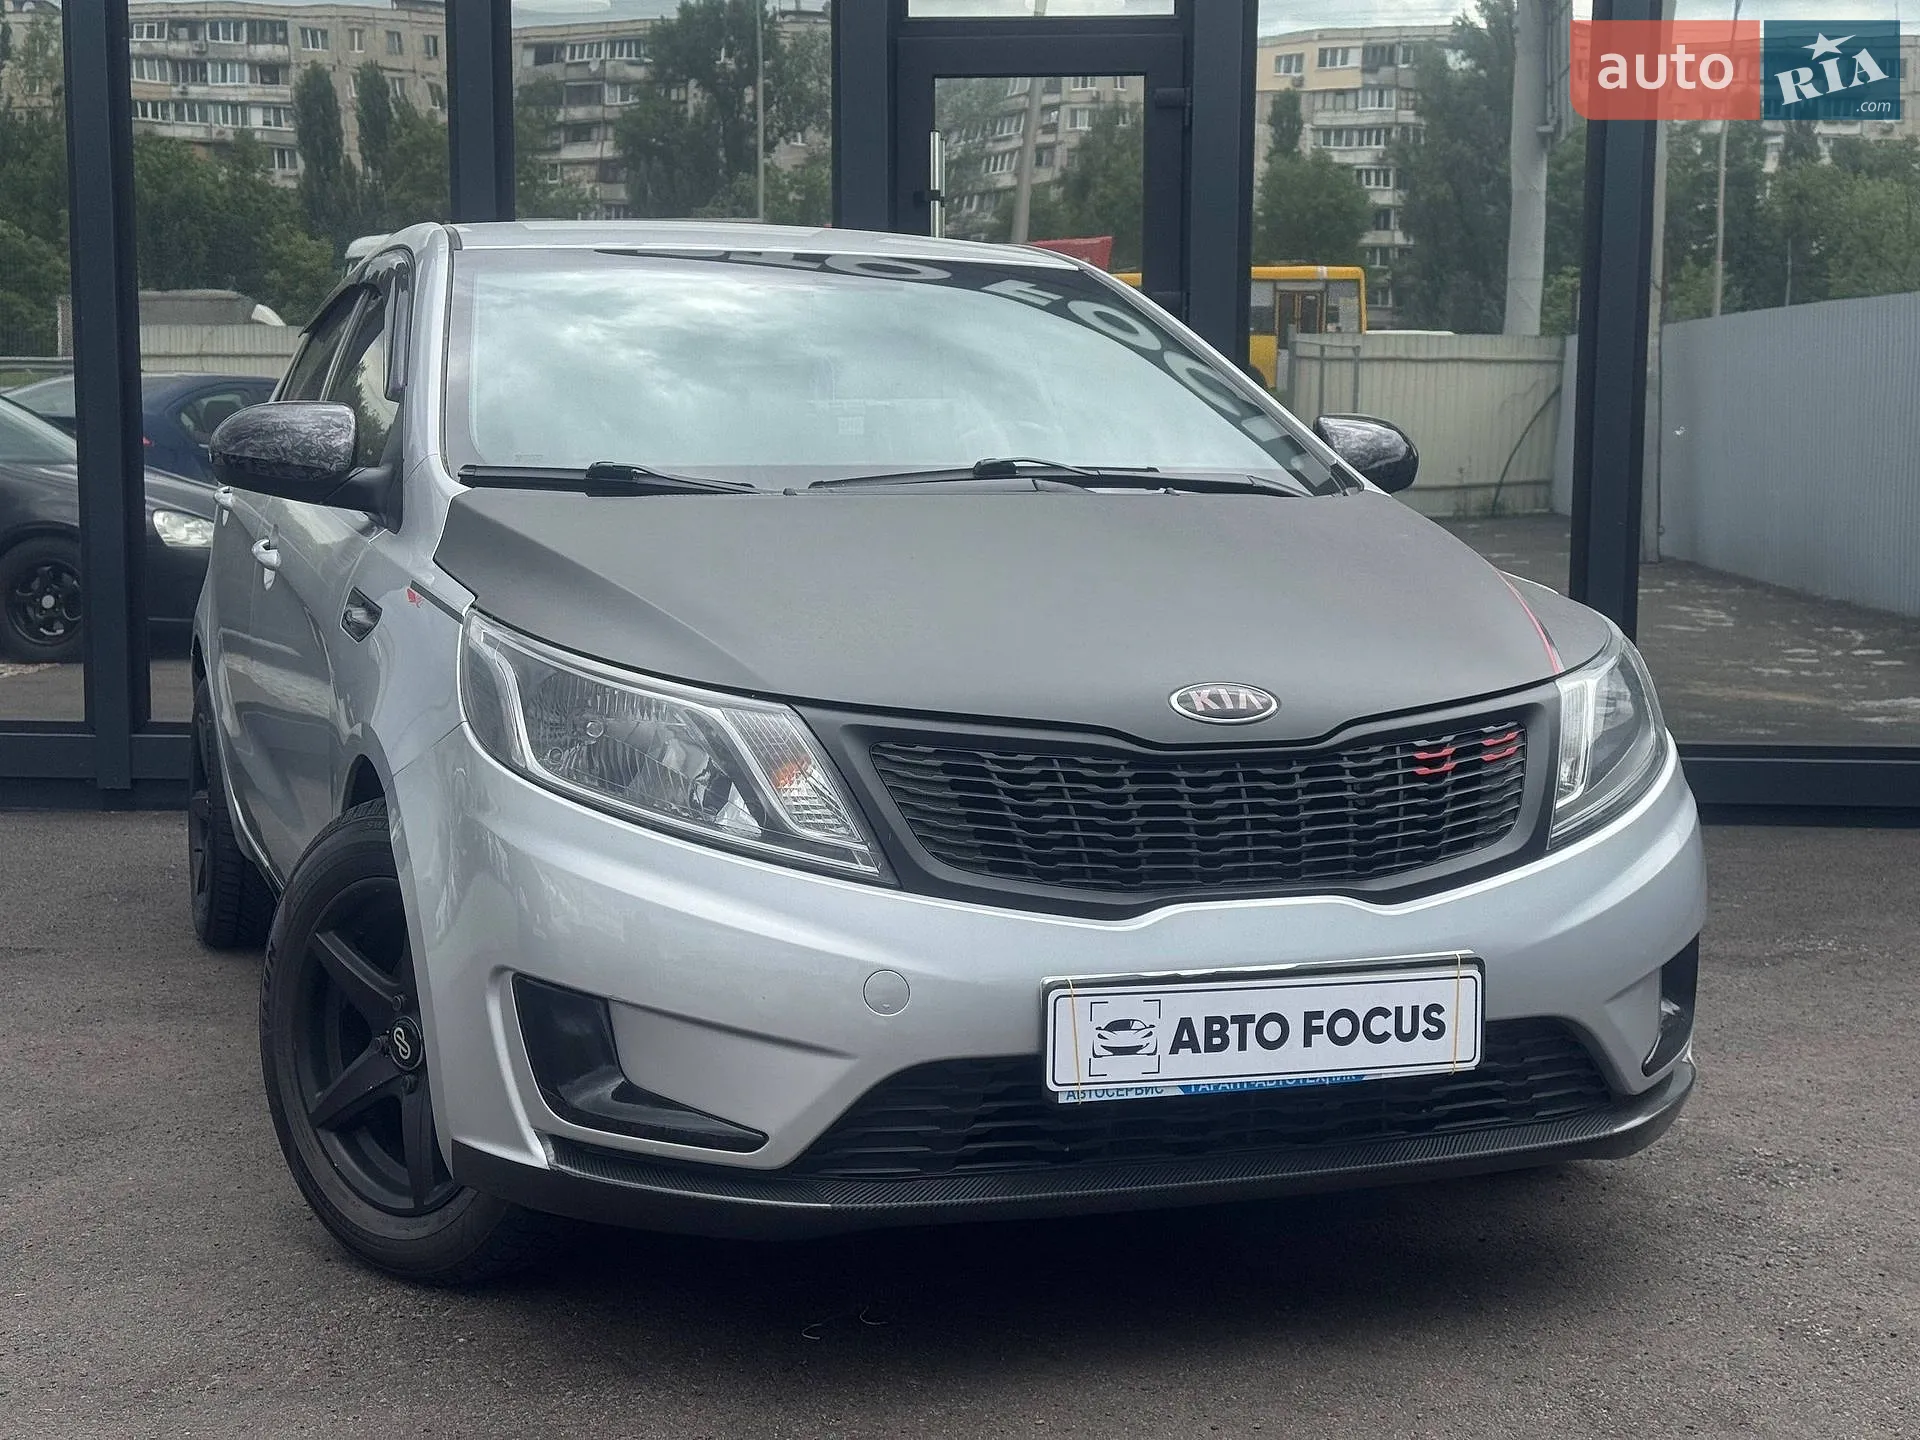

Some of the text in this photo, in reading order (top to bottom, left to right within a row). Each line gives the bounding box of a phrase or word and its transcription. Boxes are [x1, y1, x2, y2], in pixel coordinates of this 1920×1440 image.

[1188, 688, 1264, 712] KIA
[1168, 1003, 1447, 1056] АВТО FOCUS
